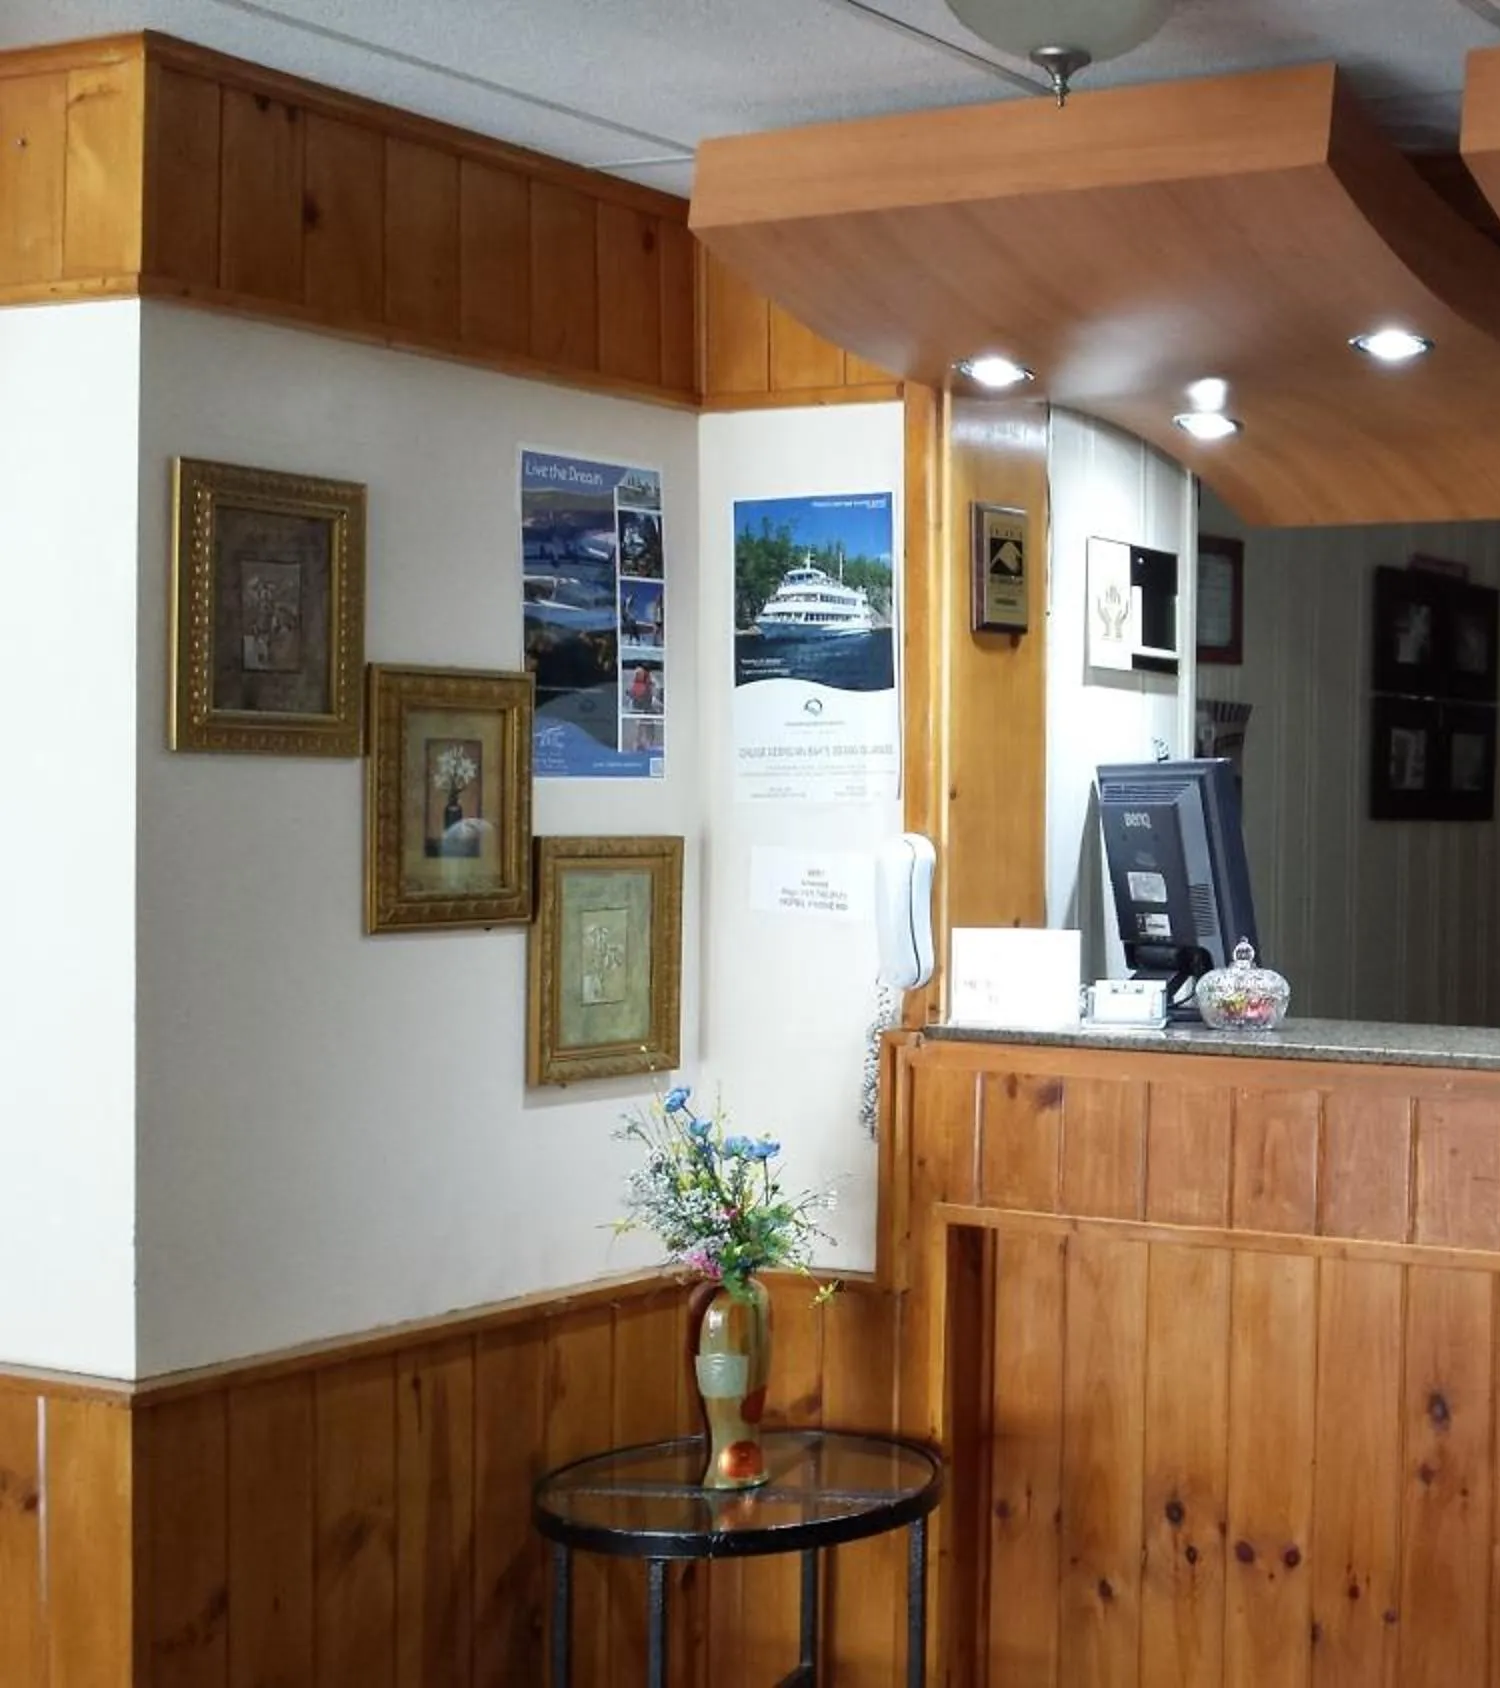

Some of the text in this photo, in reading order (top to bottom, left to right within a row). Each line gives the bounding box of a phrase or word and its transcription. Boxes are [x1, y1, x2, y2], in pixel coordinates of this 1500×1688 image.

[525, 458, 603, 486] Live the Dream
